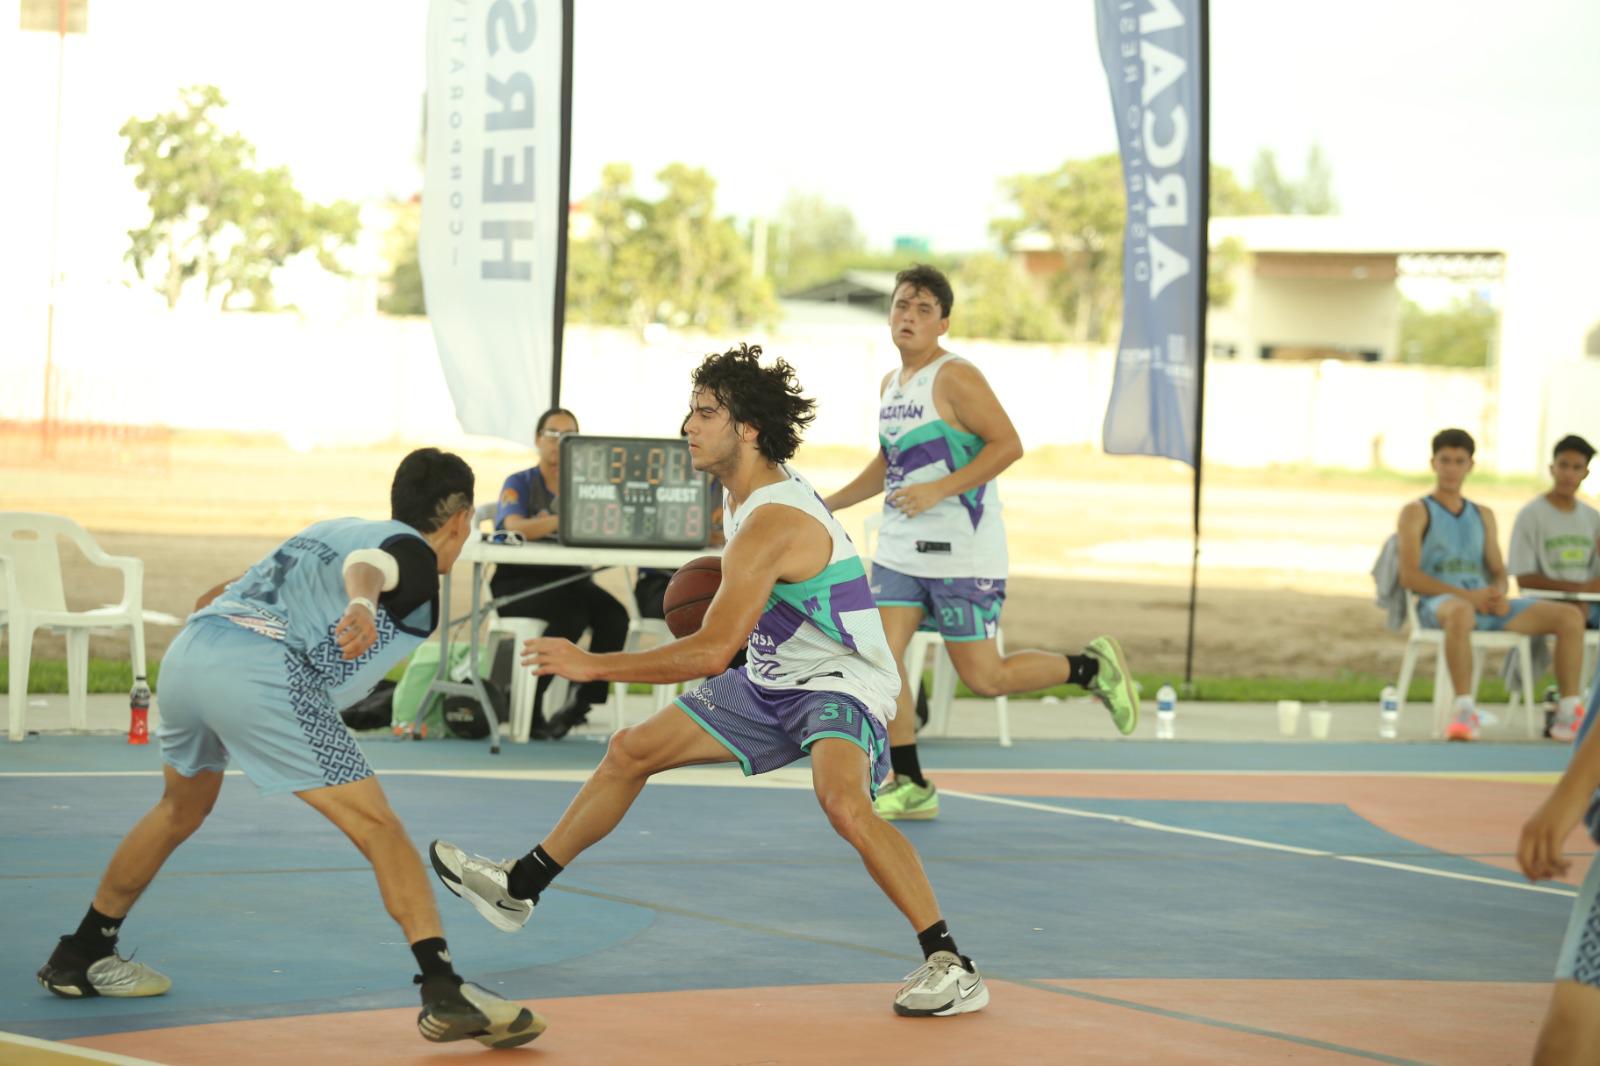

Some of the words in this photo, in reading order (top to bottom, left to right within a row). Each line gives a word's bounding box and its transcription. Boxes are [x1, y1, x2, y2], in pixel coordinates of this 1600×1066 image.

[579, 484, 616, 500] HOME
[656, 487, 698, 502] GUEST
[939, 607, 965, 627] 21
[820, 703, 853, 723] 31
